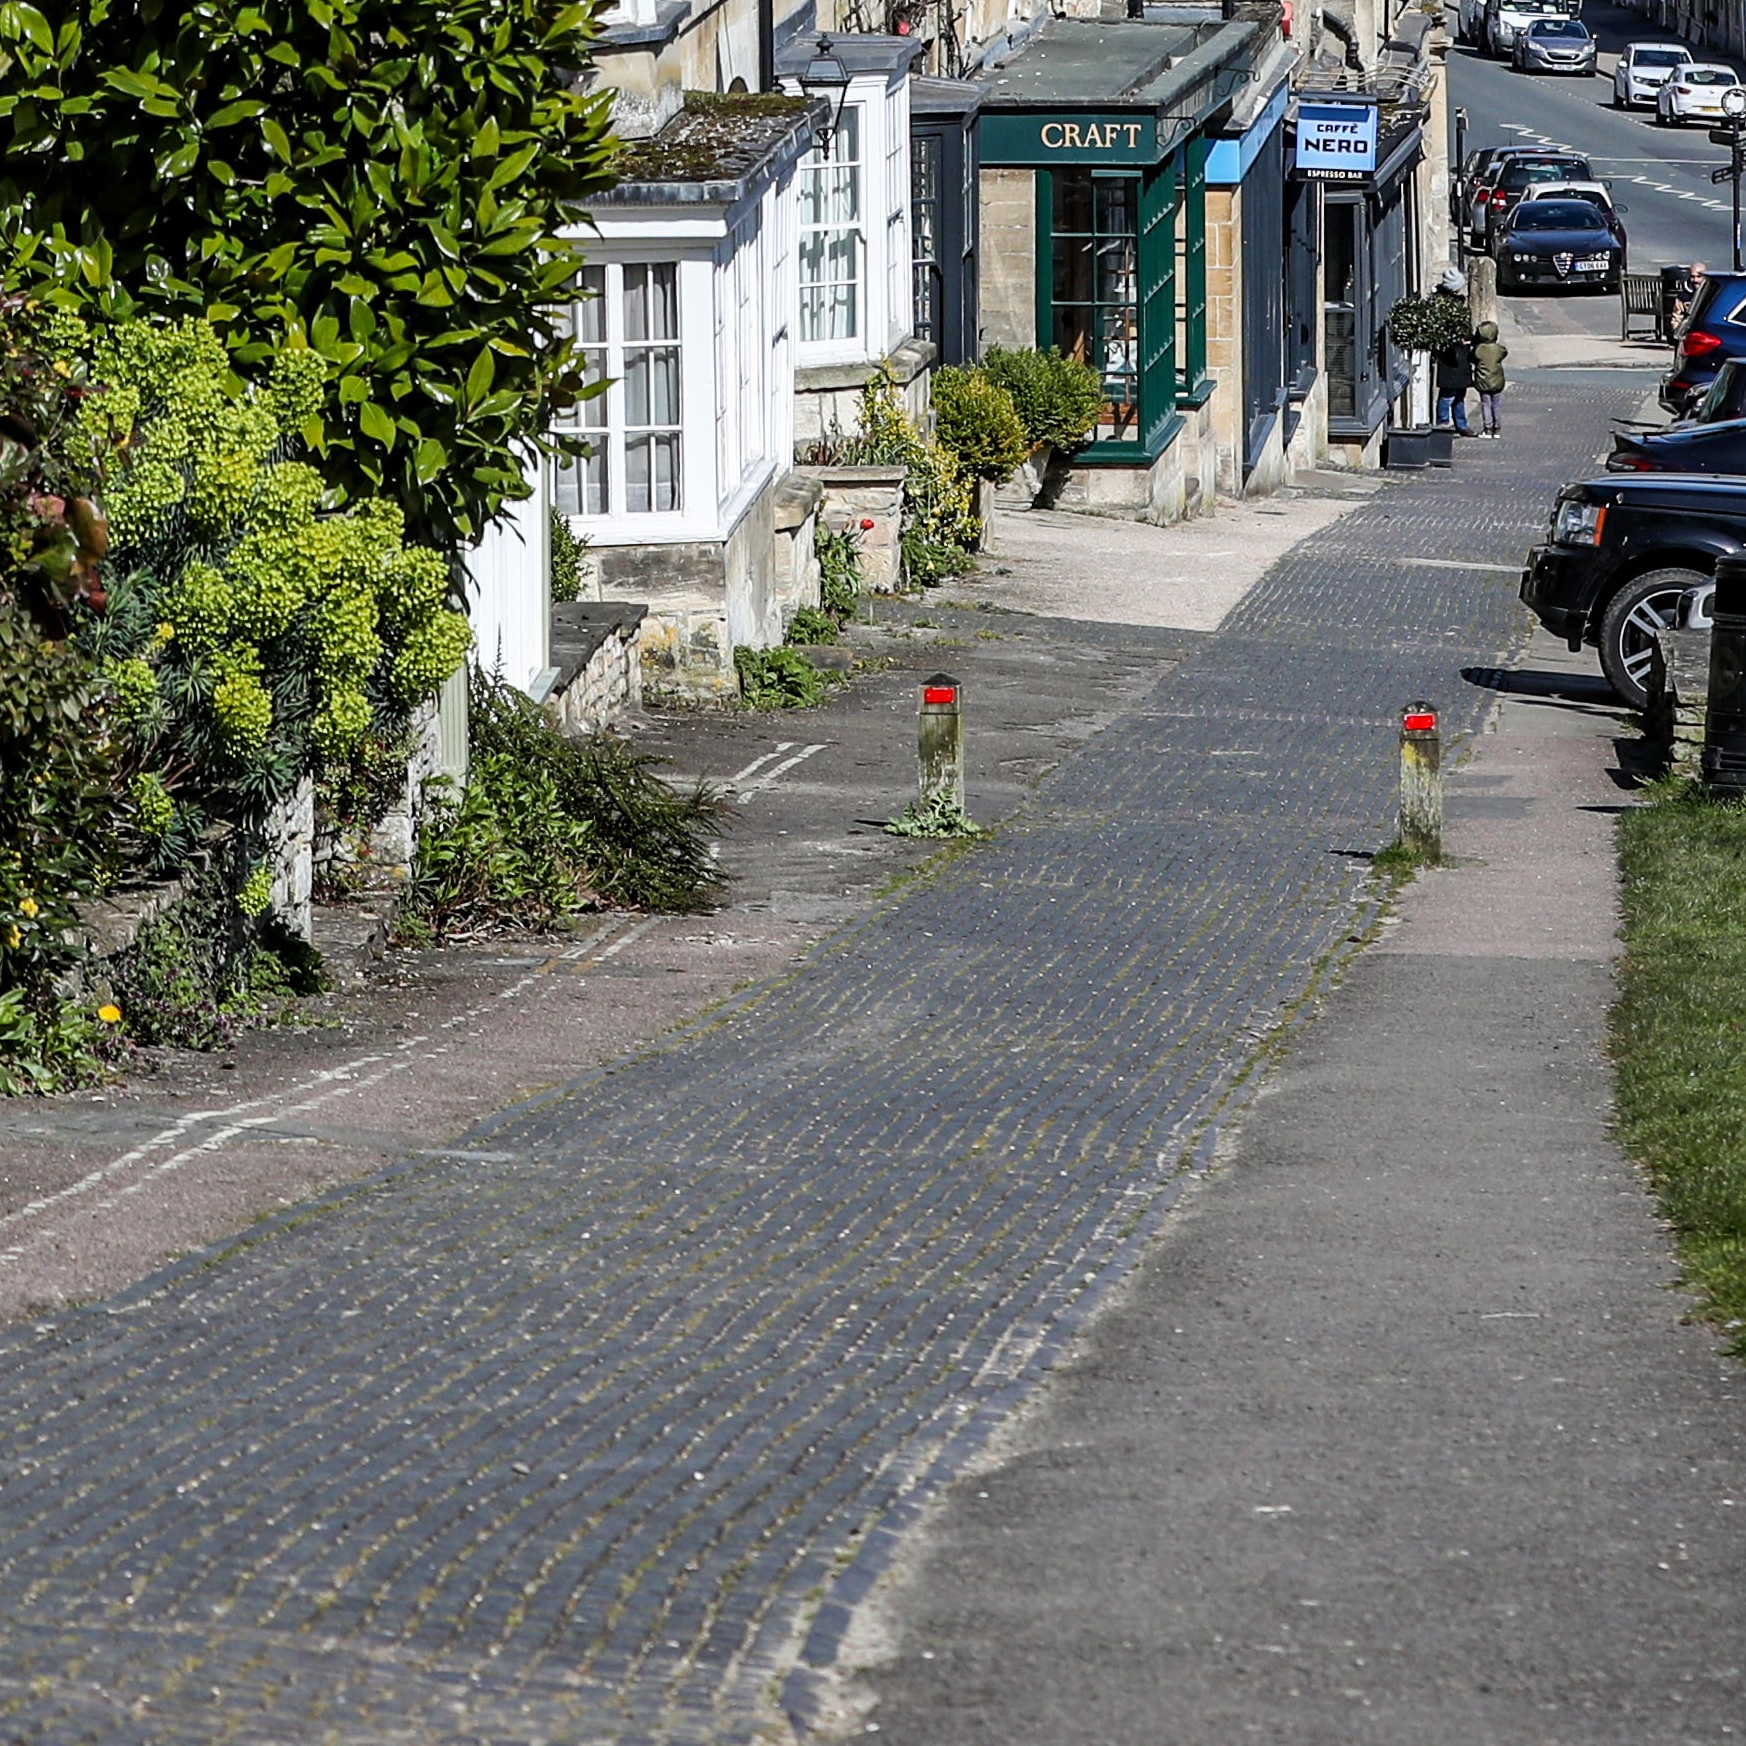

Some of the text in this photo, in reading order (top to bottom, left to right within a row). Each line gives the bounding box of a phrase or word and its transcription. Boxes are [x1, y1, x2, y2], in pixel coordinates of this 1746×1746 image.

[1317, 122, 1358, 134] CAFFÈ
[1040, 123, 1142, 148] CRAFT
[1304, 138, 1368, 154] NERO
[1307, 169, 1363, 180] ESPRESSO BAR
